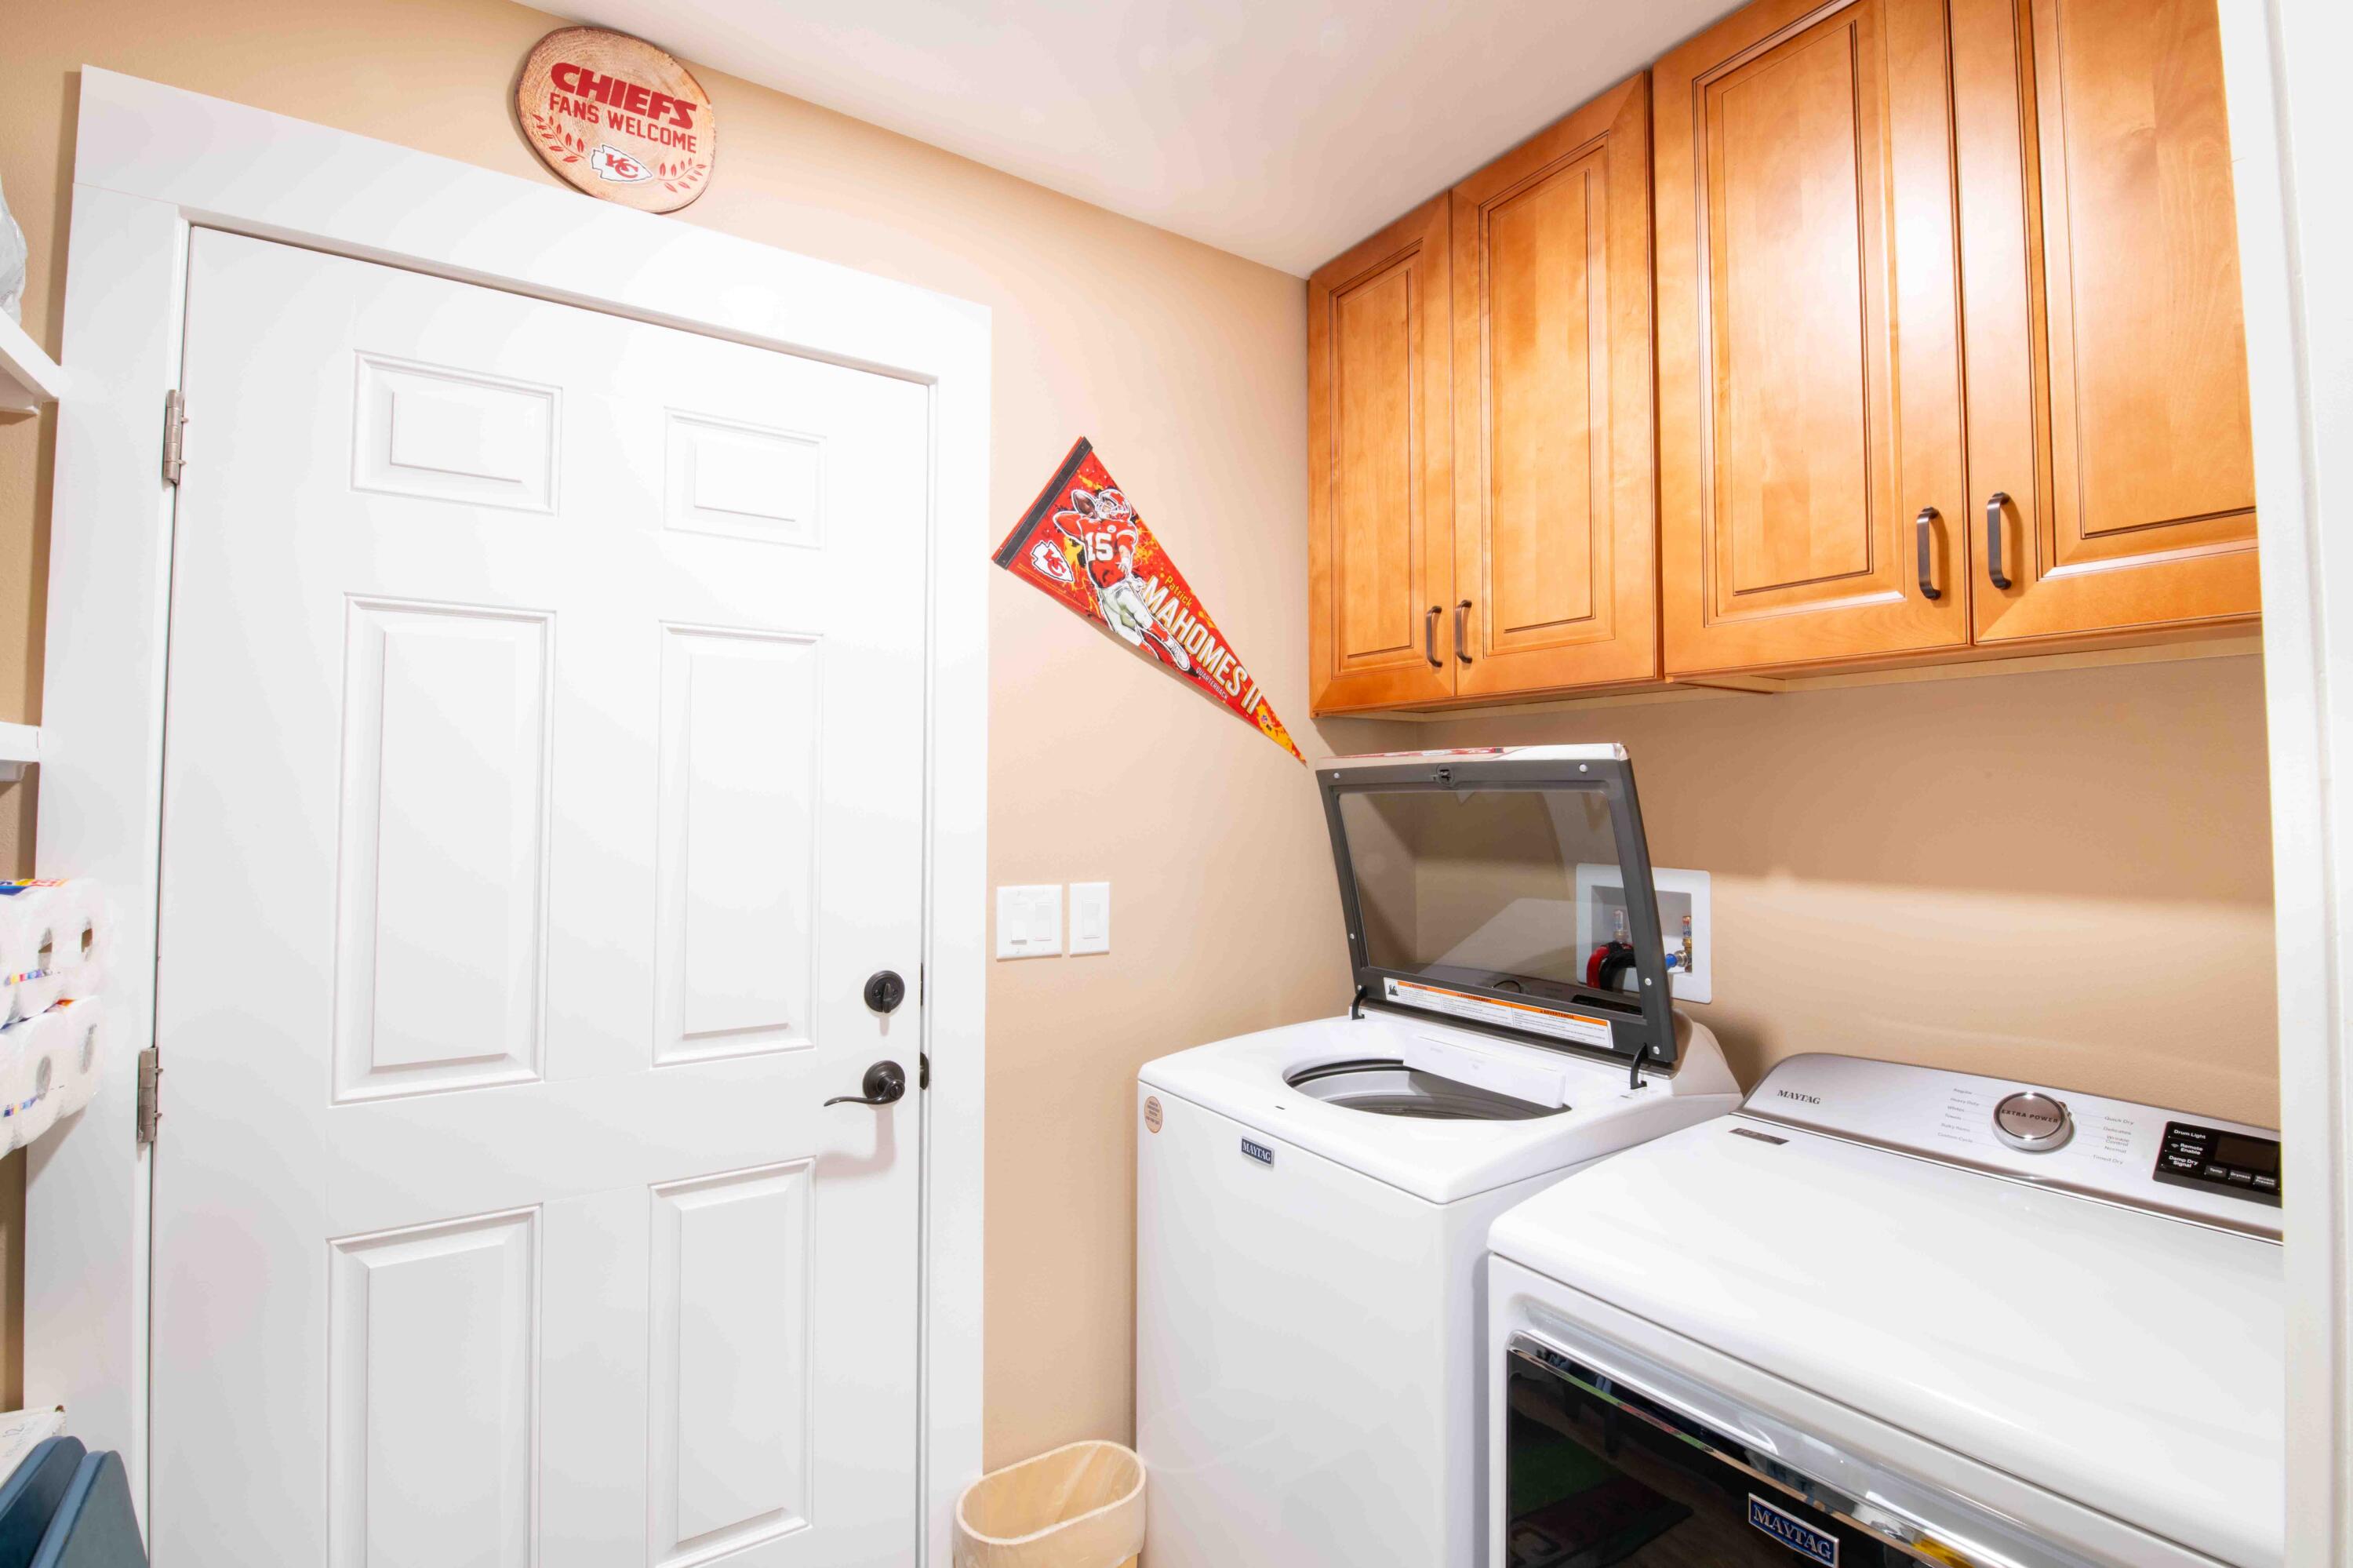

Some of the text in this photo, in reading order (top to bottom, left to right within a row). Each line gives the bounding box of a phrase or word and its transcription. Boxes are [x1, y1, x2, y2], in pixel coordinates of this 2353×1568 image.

[551, 62, 696, 129] CHIEFS
[550, 93, 697, 154] FANS WELCOME
[606, 153, 639, 179] KC
[1086, 533, 1114, 561] 15
[1165, 575, 1193, 608] Patrick
[1143, 575, 1263, 715] MAHOMES II
[1195, 667, 1228, 700] QUARTERBACK
[1777, 1090, 1820, 1105] MAYTAG
[2001, 1109, 2059, 1123] EXTRA POWER
[1243, 1141, 1271, 1162] MAYTAG
[2180, 1143, 2203, 1151] Remote
[1754, 1504, 1831, 1560] MAYTAG
